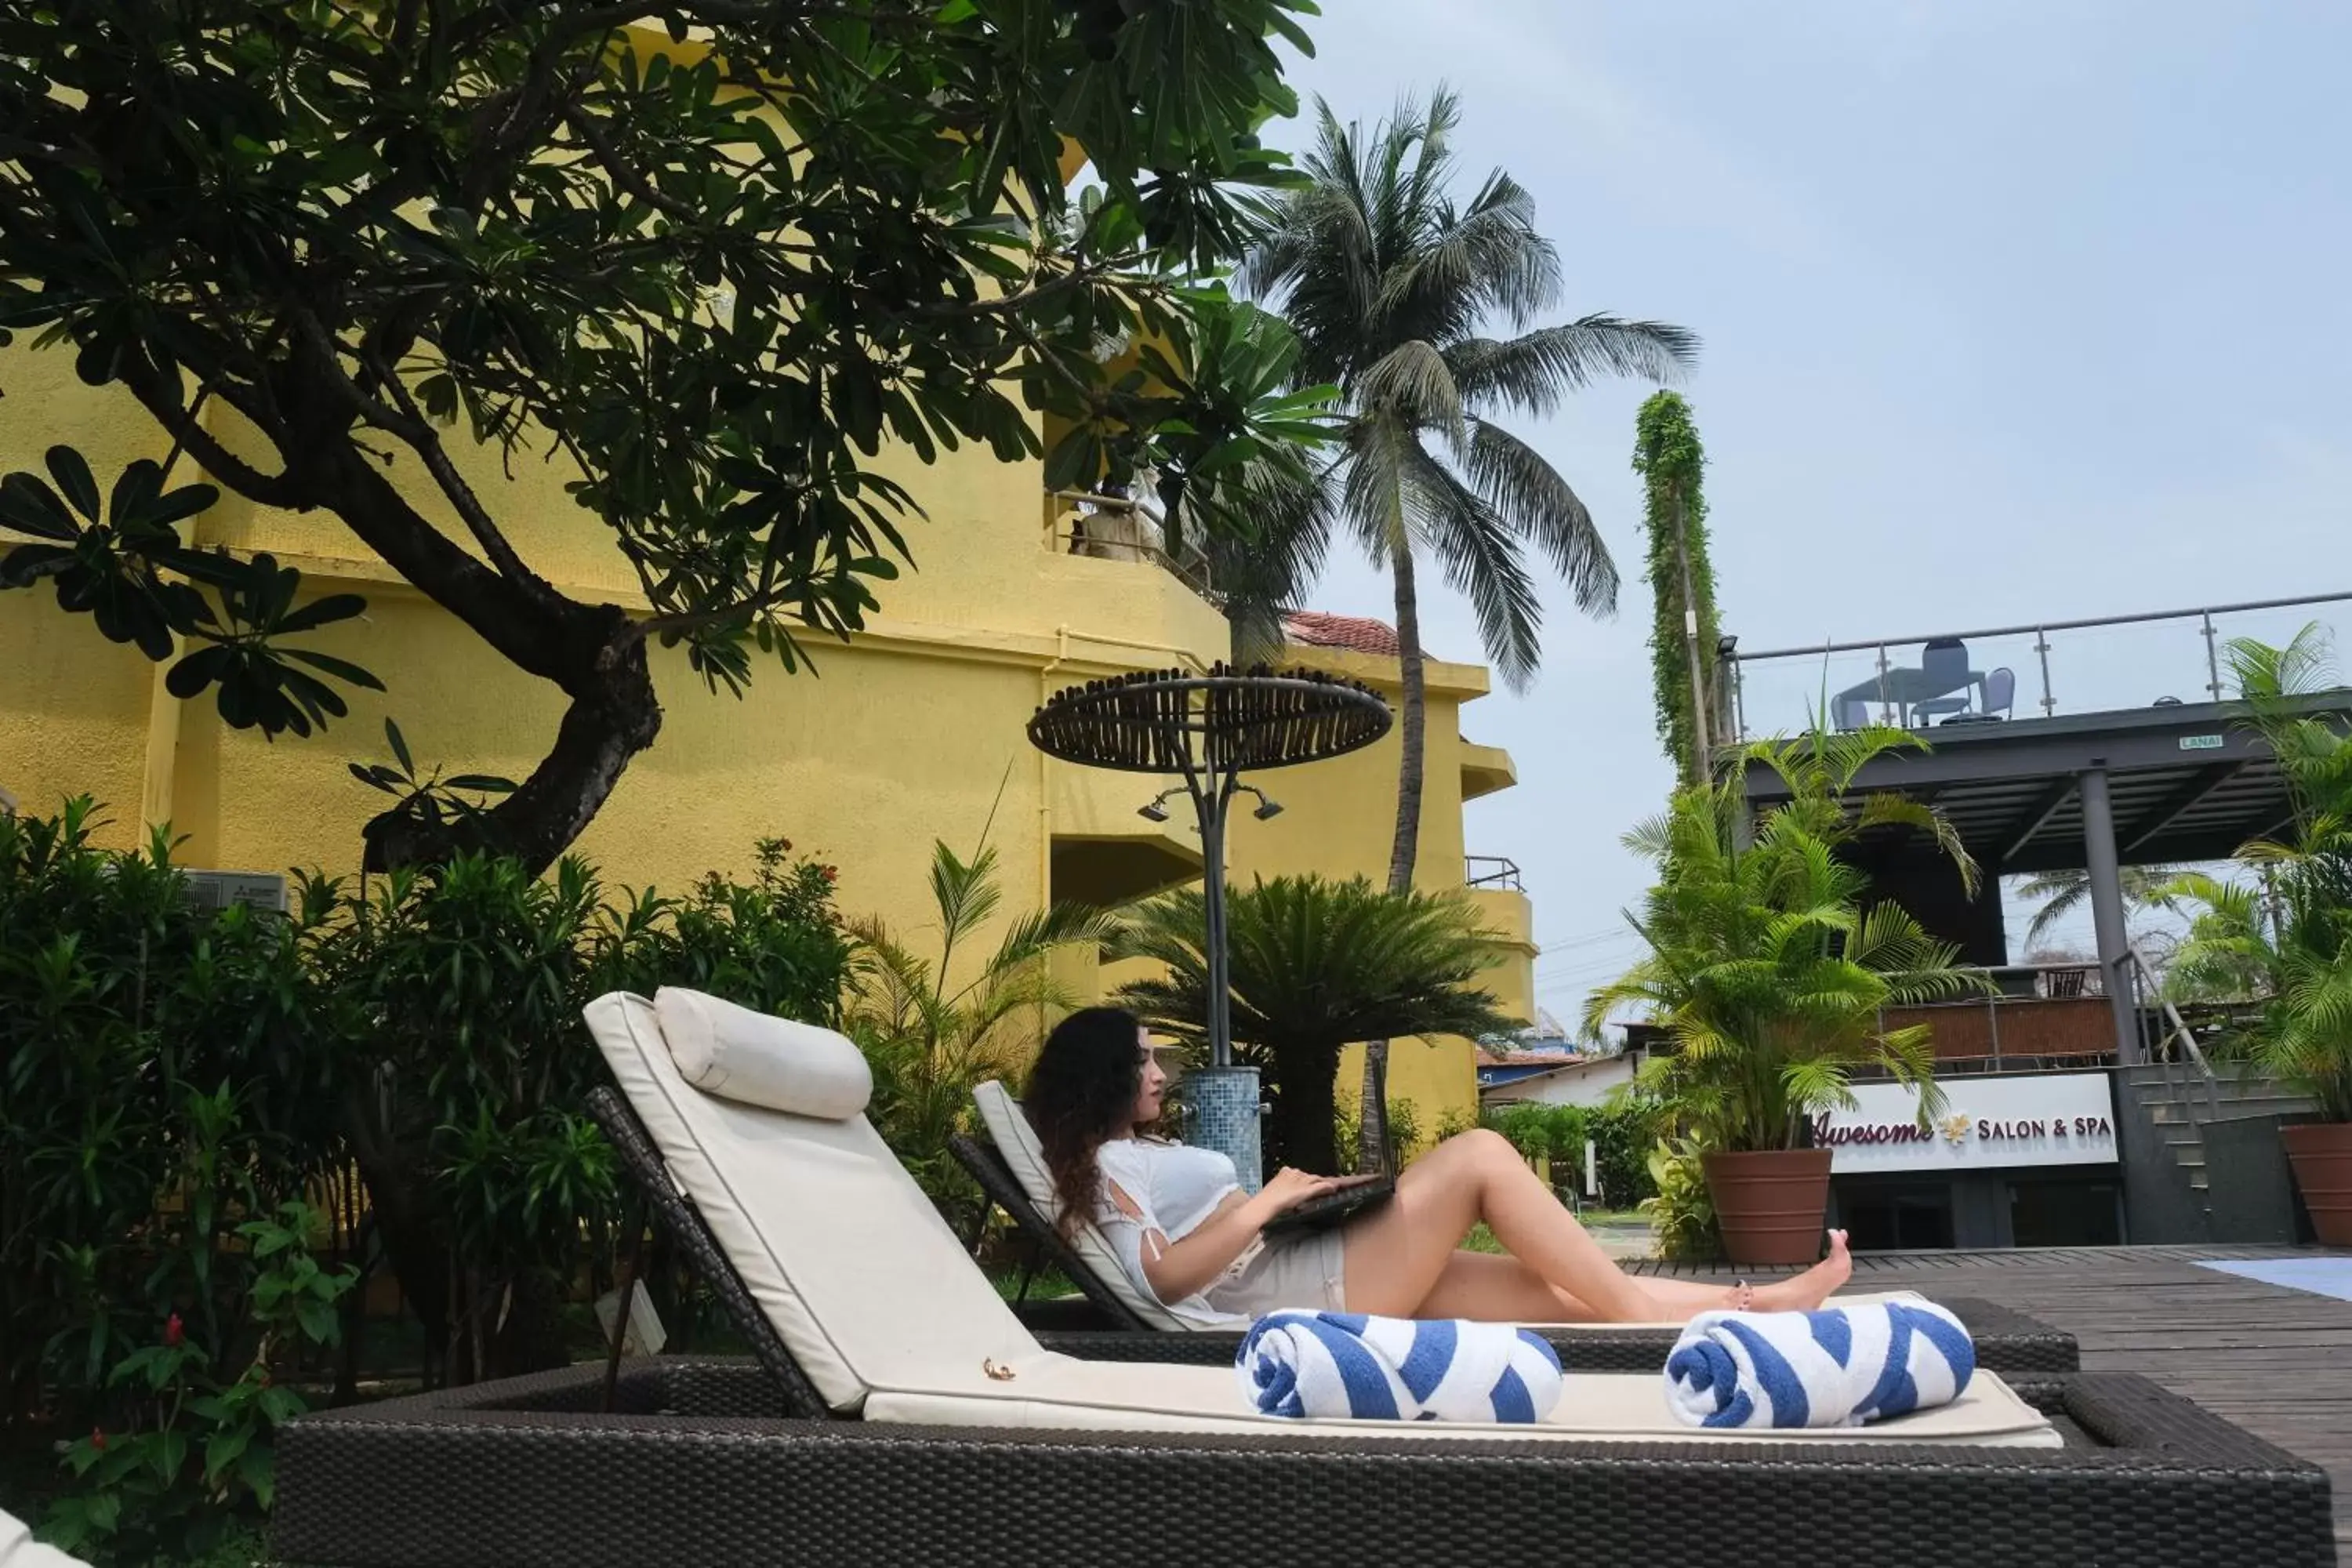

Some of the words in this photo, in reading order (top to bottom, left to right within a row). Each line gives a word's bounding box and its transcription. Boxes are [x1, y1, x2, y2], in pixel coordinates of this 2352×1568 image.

[1978, 1120, 2045, 1140] SALON
[2053, 1119, 2067, 1137] &
[2075, 1117, 2111, 1136] SPA
